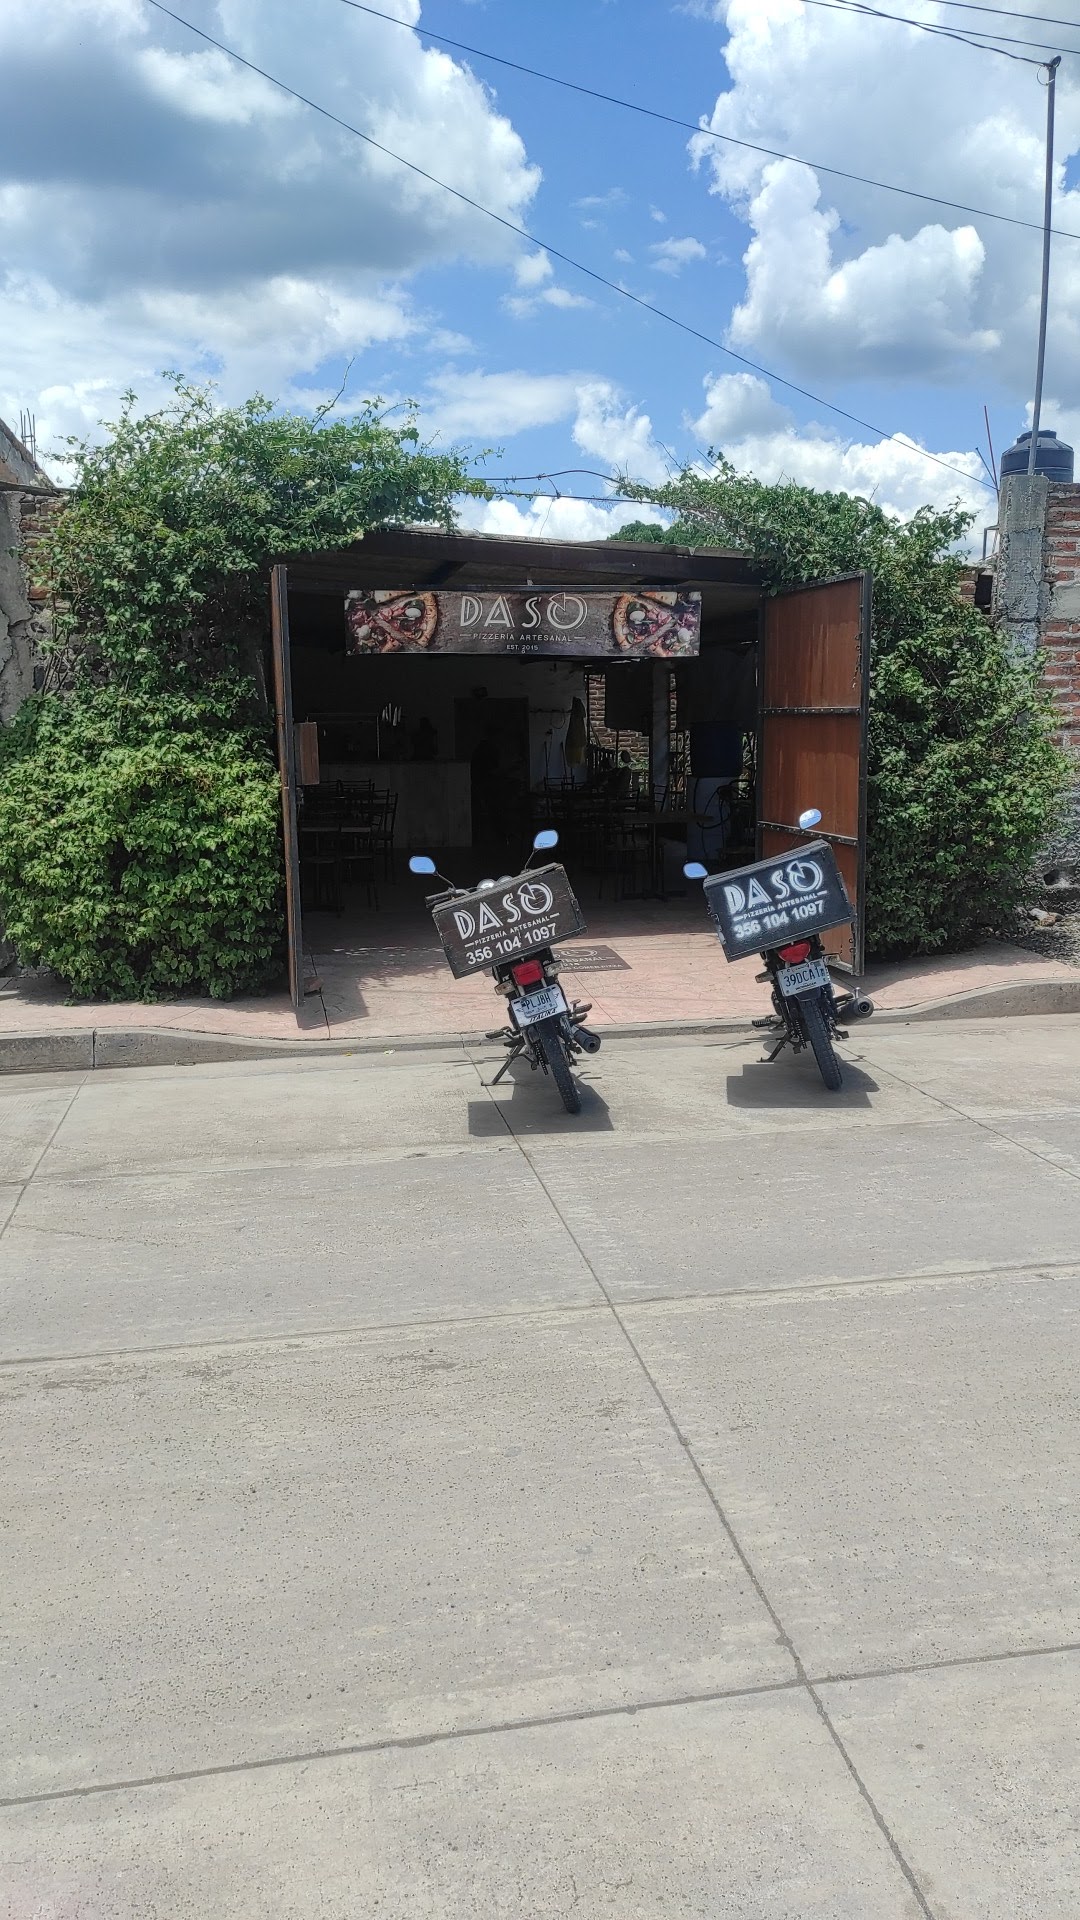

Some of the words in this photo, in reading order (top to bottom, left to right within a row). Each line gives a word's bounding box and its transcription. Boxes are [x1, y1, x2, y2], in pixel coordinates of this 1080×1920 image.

[460, 592, 588, 630] DASO
[519, 633, 573, 642] ARTESANAL
[723, 860, 823, 915] DASO
[743, 905, 776, 920] PIZZERÍA
[777, 892, 818, 910] ARTESANAL
[453, 882, 553, 940] DASO
[733, 919, 761, 938] 356
[763, 911, 790, 929] 104
[791, 899, 824, 920] 1097
[466, 946, 493, 965] 356
[495, 936, 522, 954] 104
[524, 922, 557, 944] 1097
[474, 930, 507, 946] PIZZERÍA
[510, 915, 550, 934] ARTESANAL
